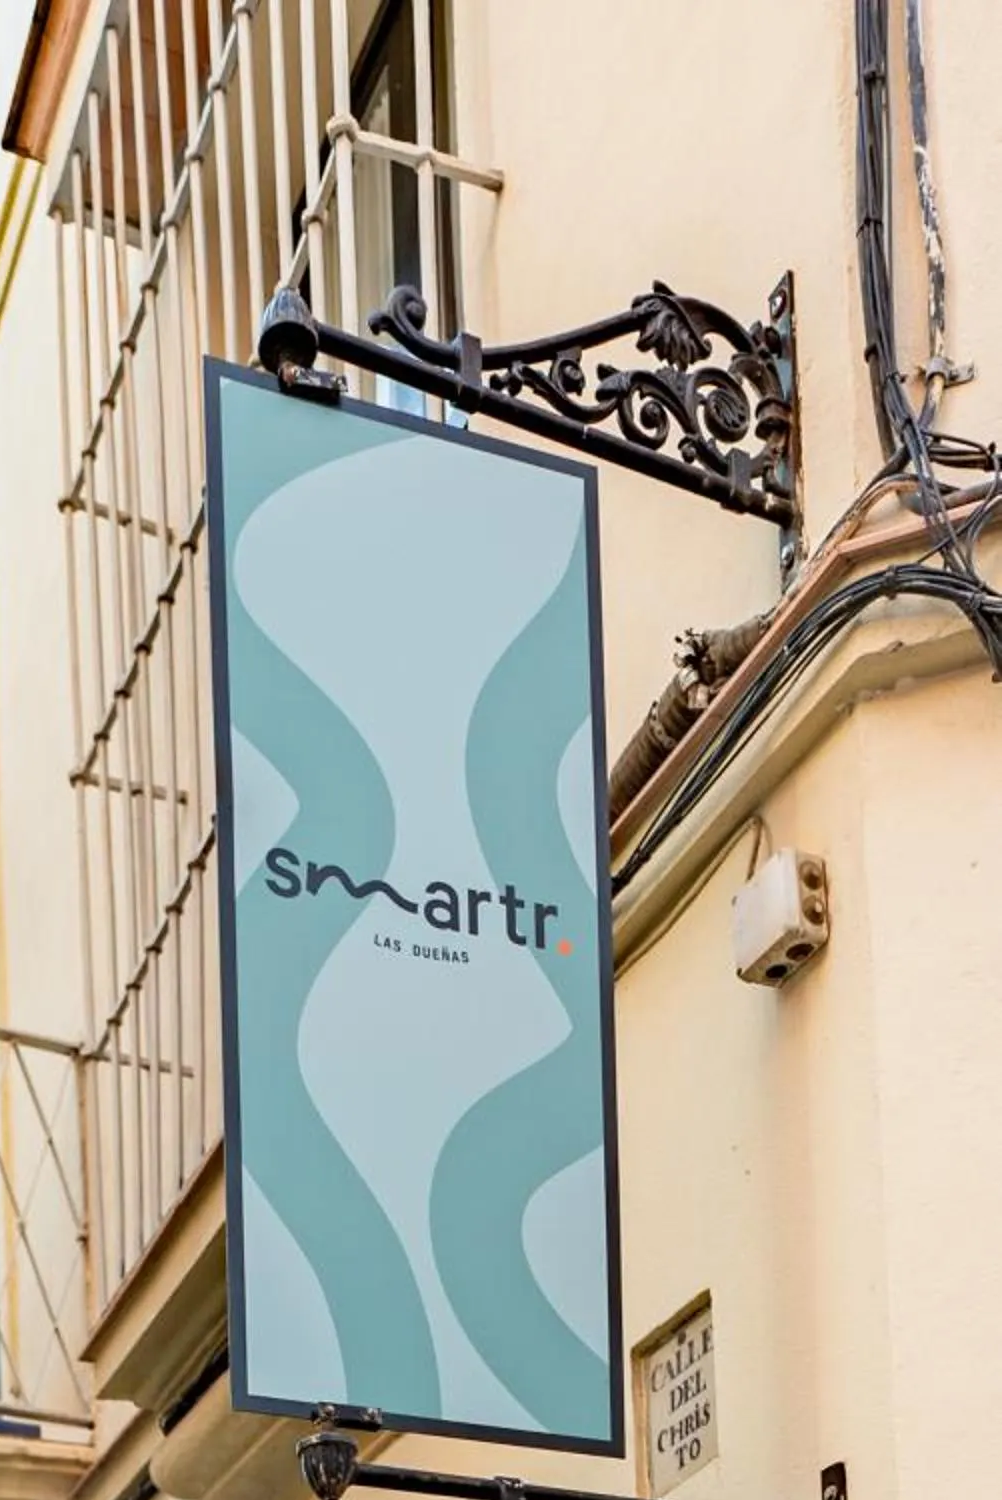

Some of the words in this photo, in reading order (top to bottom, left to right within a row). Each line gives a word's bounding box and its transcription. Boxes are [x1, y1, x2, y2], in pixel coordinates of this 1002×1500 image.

[374, 933, 402, 953] LAS
[412, 942, 470, 964] DUEÑAS
[651, 1326, 714, 1393] CALLE
[669, 1371, 707, 1414] DEL
[675, 1438, 702, 1470] TO
